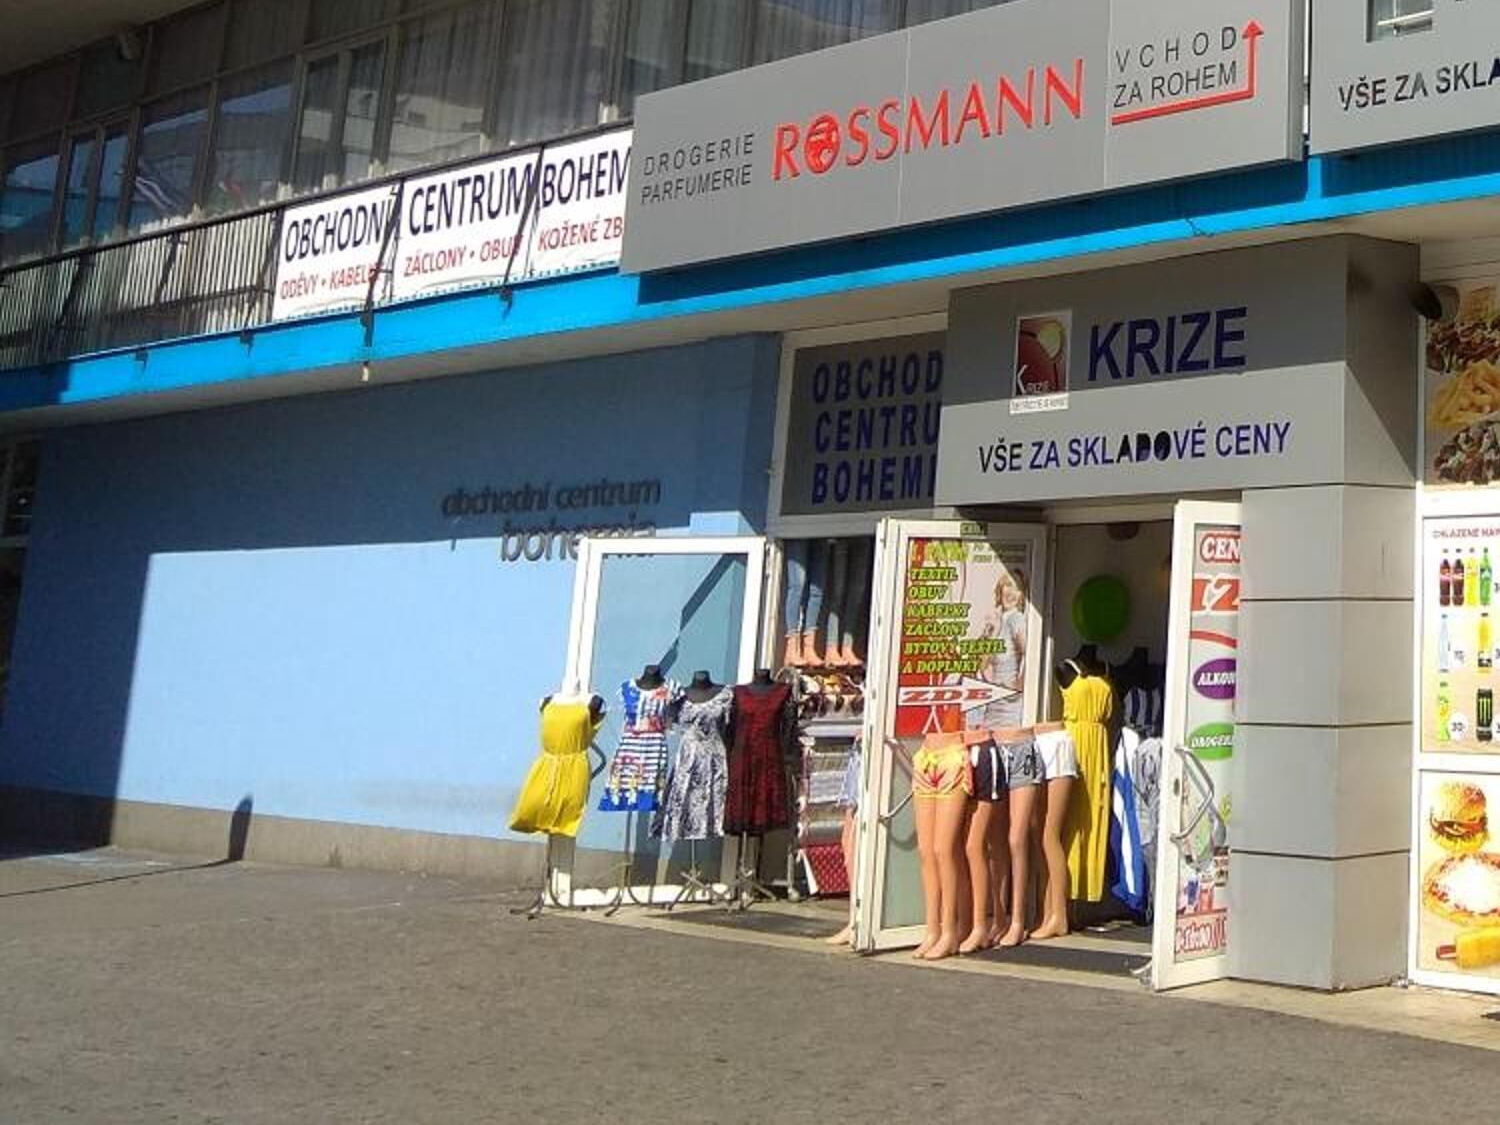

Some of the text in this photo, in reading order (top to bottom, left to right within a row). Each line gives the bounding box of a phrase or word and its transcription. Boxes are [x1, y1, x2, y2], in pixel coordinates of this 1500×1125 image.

[1115, 25, 1239, 74] VCHOD
[1112, 59, 1239, 109] ZA ROHEM
[1338, 74, 1388, 113] VŠE
[1393, 71, 1430, 105] ZA
[770, 57, 1085, 182] ROSSMANN
[644, 133, 756, 177] DROGERIE
[640, 163, 753, 205] PARFUMERIE
[284, 185, 398, 263] OBCHODNÍ
[409, 163, 537, 236] CENTRUM
[279, 269, 319, 300] ODĚVY
[403, 245, 467, 278] ZÁCLONY
[537, 213, 601, 252] KOŽENÉ
[1087, 306, 1248, 381] KRIZE
[813, 350, 944, 404] OBCHOD
[815, 400, 942, 453] CENTRU
[978, 421, 1291, 474] VŠE ZA SKLADOVÉ CENY
[441, 478, 662, 517] obchodní centrum
[811, 453, 938, 505] BOHEMI
